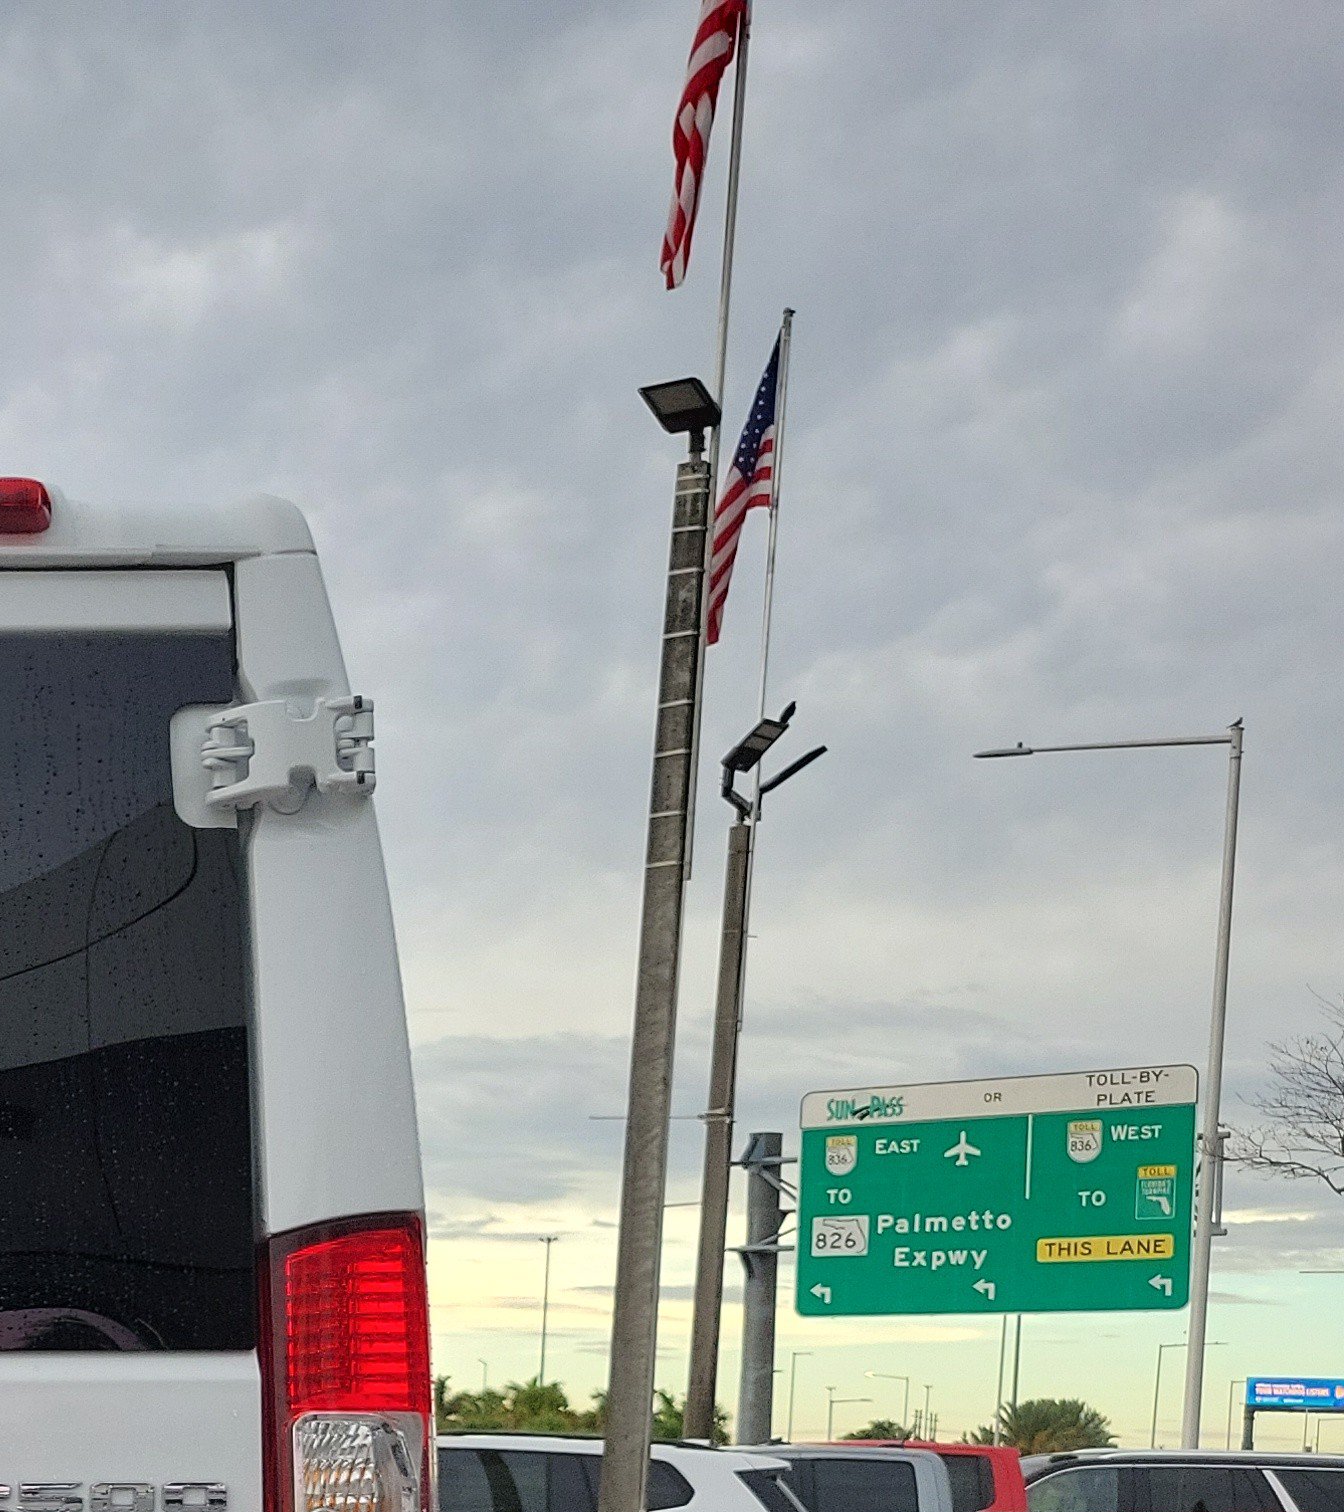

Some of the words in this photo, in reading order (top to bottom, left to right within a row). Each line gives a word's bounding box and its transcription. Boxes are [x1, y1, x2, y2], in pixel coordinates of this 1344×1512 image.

[1086, 1070, 1169, 1087] TOLL-BY-
[983, 1092, 1002, 1102] OR
[1096, 1090, 1156, 1106] PLATE
[1110, 1124, 1162, 1142] WEST
[875, 1139, 921, 1154] EAST
[1070, 1140, 1092, 1152] 836
[1143, 1167, 1170, 1176] TOLL
[826, 1188, 853, 1204] TO
[1078, 1190, 1106, 1207] TO
[877, 1209, 1012, 1234] Palmetto
[815, 1232, 857, 1249] 826
[1044, 1241, 1092, 1257] THIS
[1106, 1239, 1166, 1255] LANE
[893, 1247, 988, 1270] Expwy
